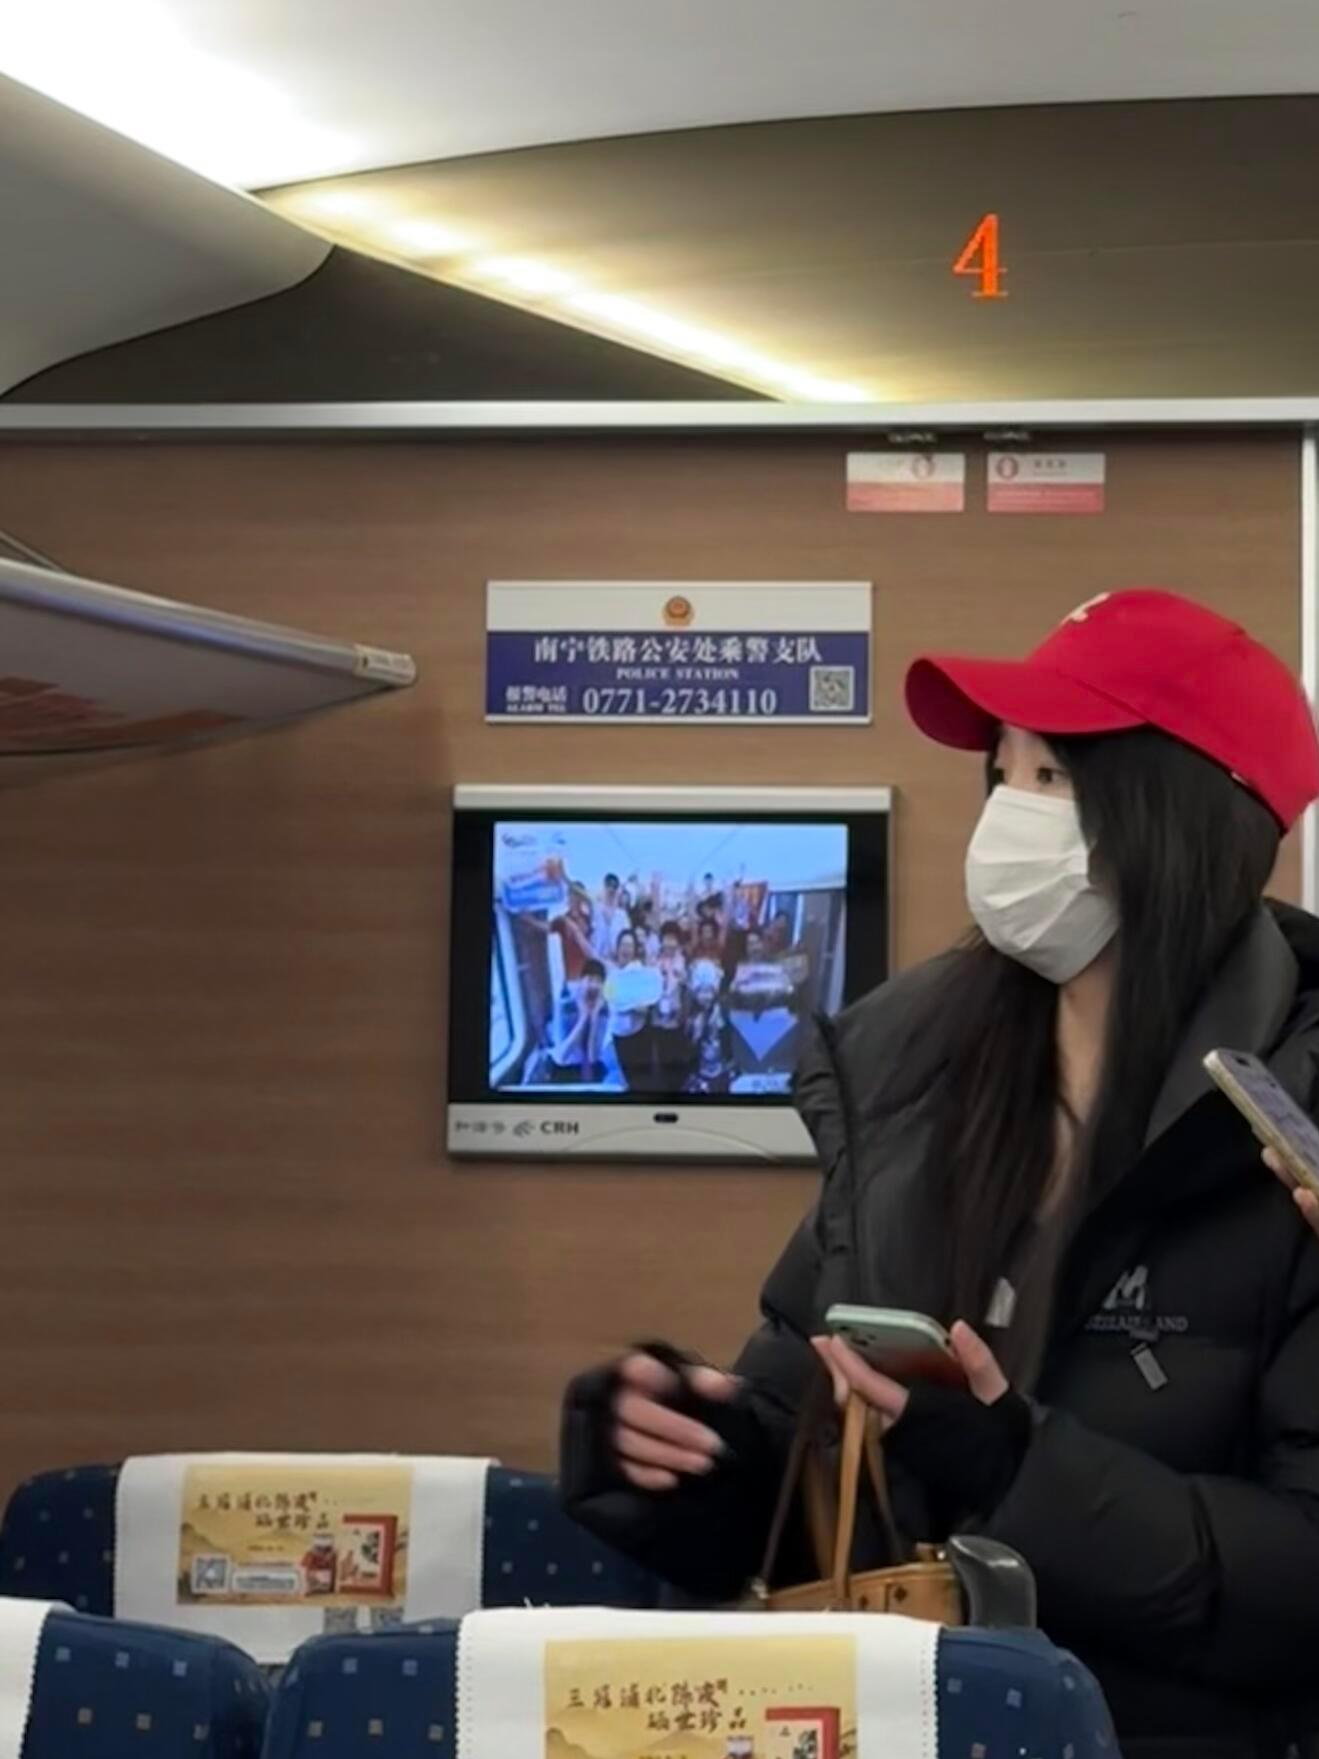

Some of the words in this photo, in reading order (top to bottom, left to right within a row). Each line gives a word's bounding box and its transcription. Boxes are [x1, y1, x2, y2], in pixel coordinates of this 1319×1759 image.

[951, 211, 1009, 298] 4
[533, 635, 823, 664] 南宁铁路公安处乘警支队
[616, 667, 670, 680] POLICE
[675, 667, 740, 680] STATION
[582, 687, 778, 715] 0771-2734110
[540, 1120, 580, 1135] CRH
